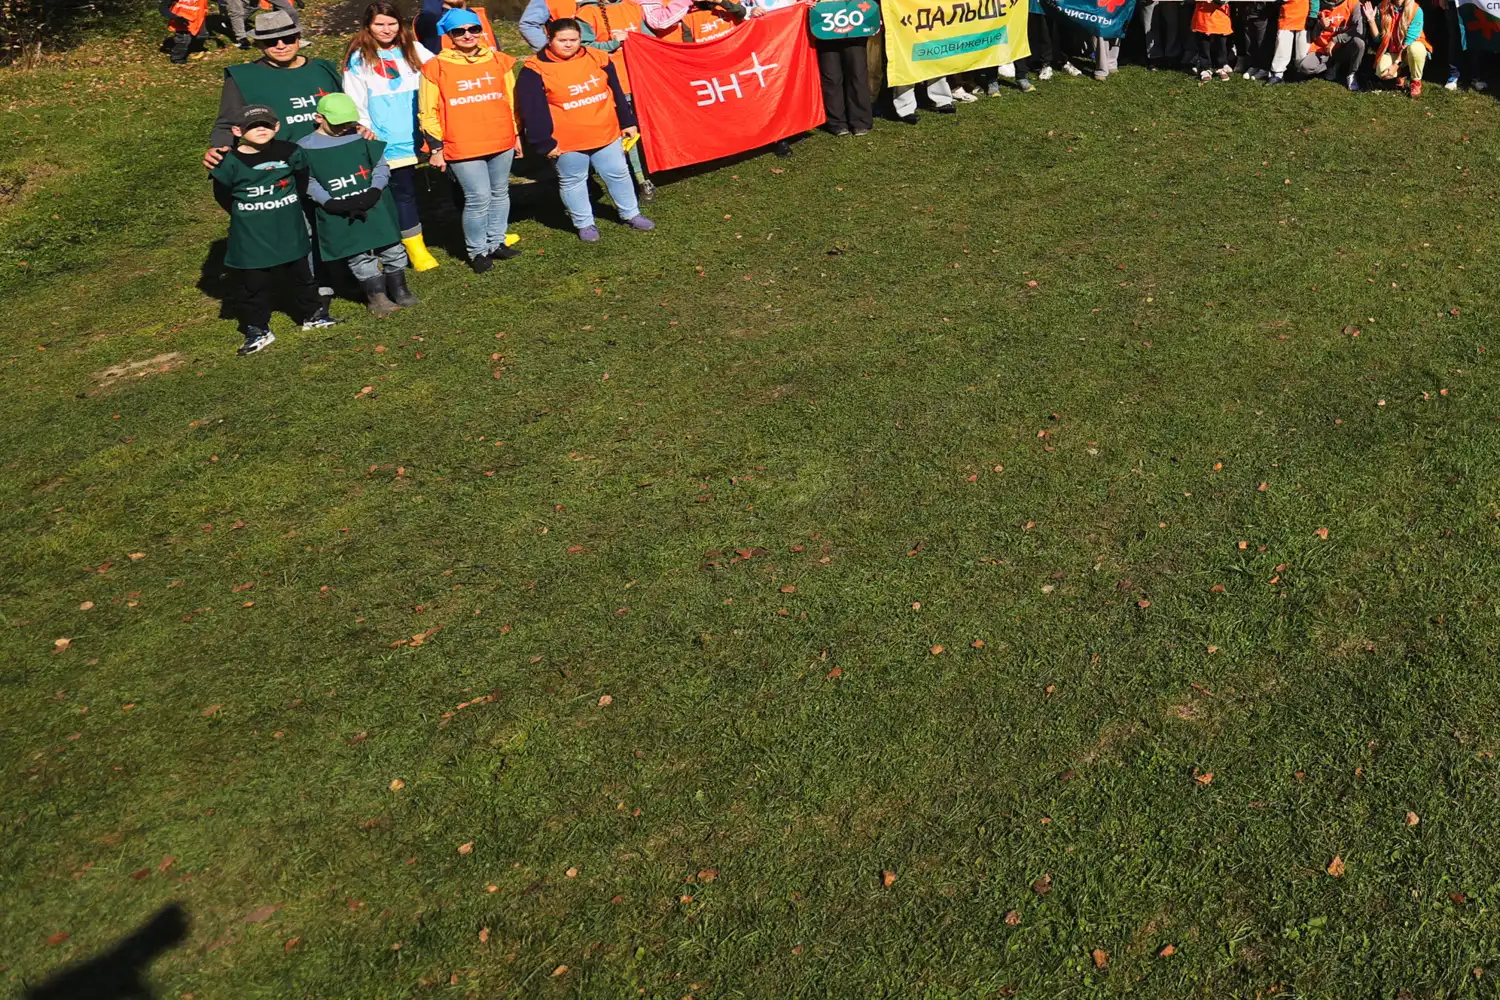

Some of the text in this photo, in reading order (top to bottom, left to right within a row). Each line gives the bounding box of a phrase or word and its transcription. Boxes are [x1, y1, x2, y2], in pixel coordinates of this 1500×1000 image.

[918, 32, 1002, 57] экодвижение
[456, 71, 496, 91] ЭН+
[567, 74, 601, 96] ЭН+
[690, 52, 778, 107] ЭН+
[289, 87, 330, 109] ЭН+
[450, 92, 503, 107] ВОЛОНТ
[562, 92, 608, 111] ВОЛОНТЕ
[286, 112, 318, 124] ВОЛО
[246, 179, 291, 198] ЭН+
[328, 165, 371, 191] ЭН+
